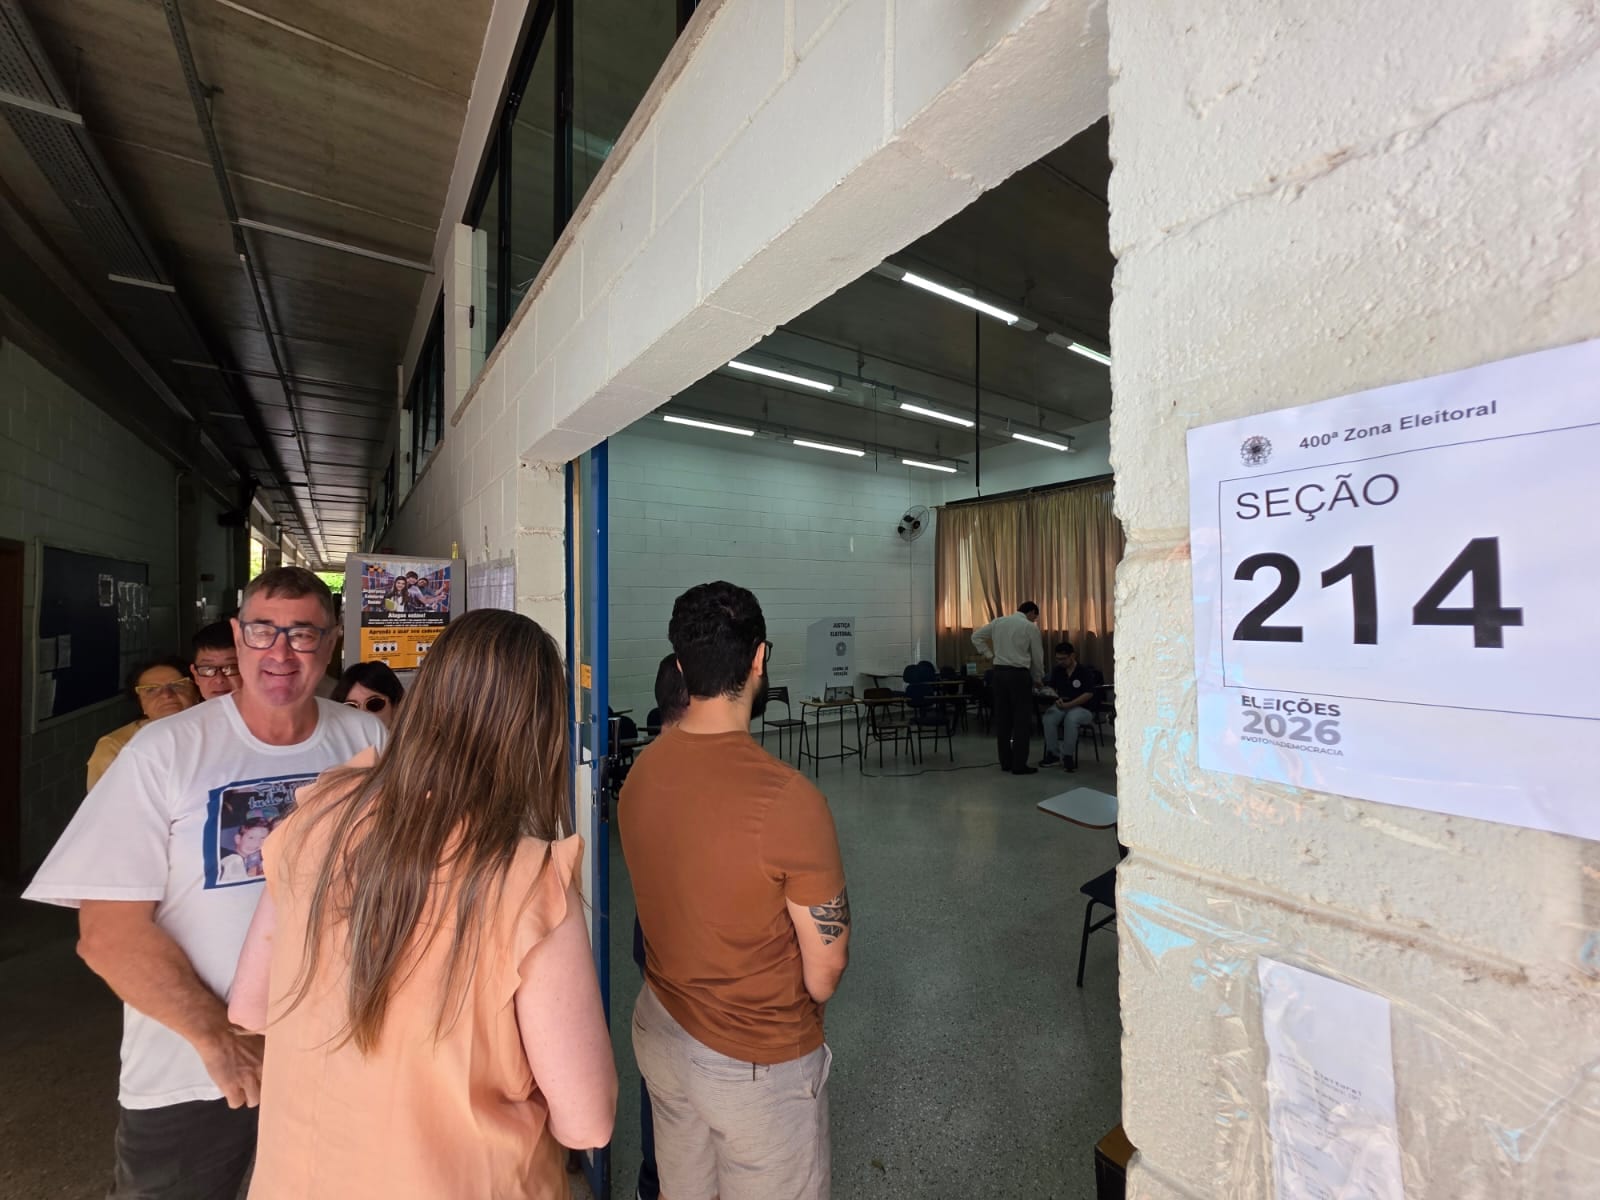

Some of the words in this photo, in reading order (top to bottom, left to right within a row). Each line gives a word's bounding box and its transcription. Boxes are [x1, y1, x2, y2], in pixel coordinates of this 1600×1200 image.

[1299, 432, 1338, 449] 400ª
[1344, 422, 1392, 442] Zona
[1400, 400, 1497, 430] Eleitoral
[1235, 473, 1400, 522] SEÇÃO
[1232, 536, 1524, 649] 214
[1241, 695, 1341, 717] ELEIÇÕES
[1241, 709, 1341, 745] 2026
